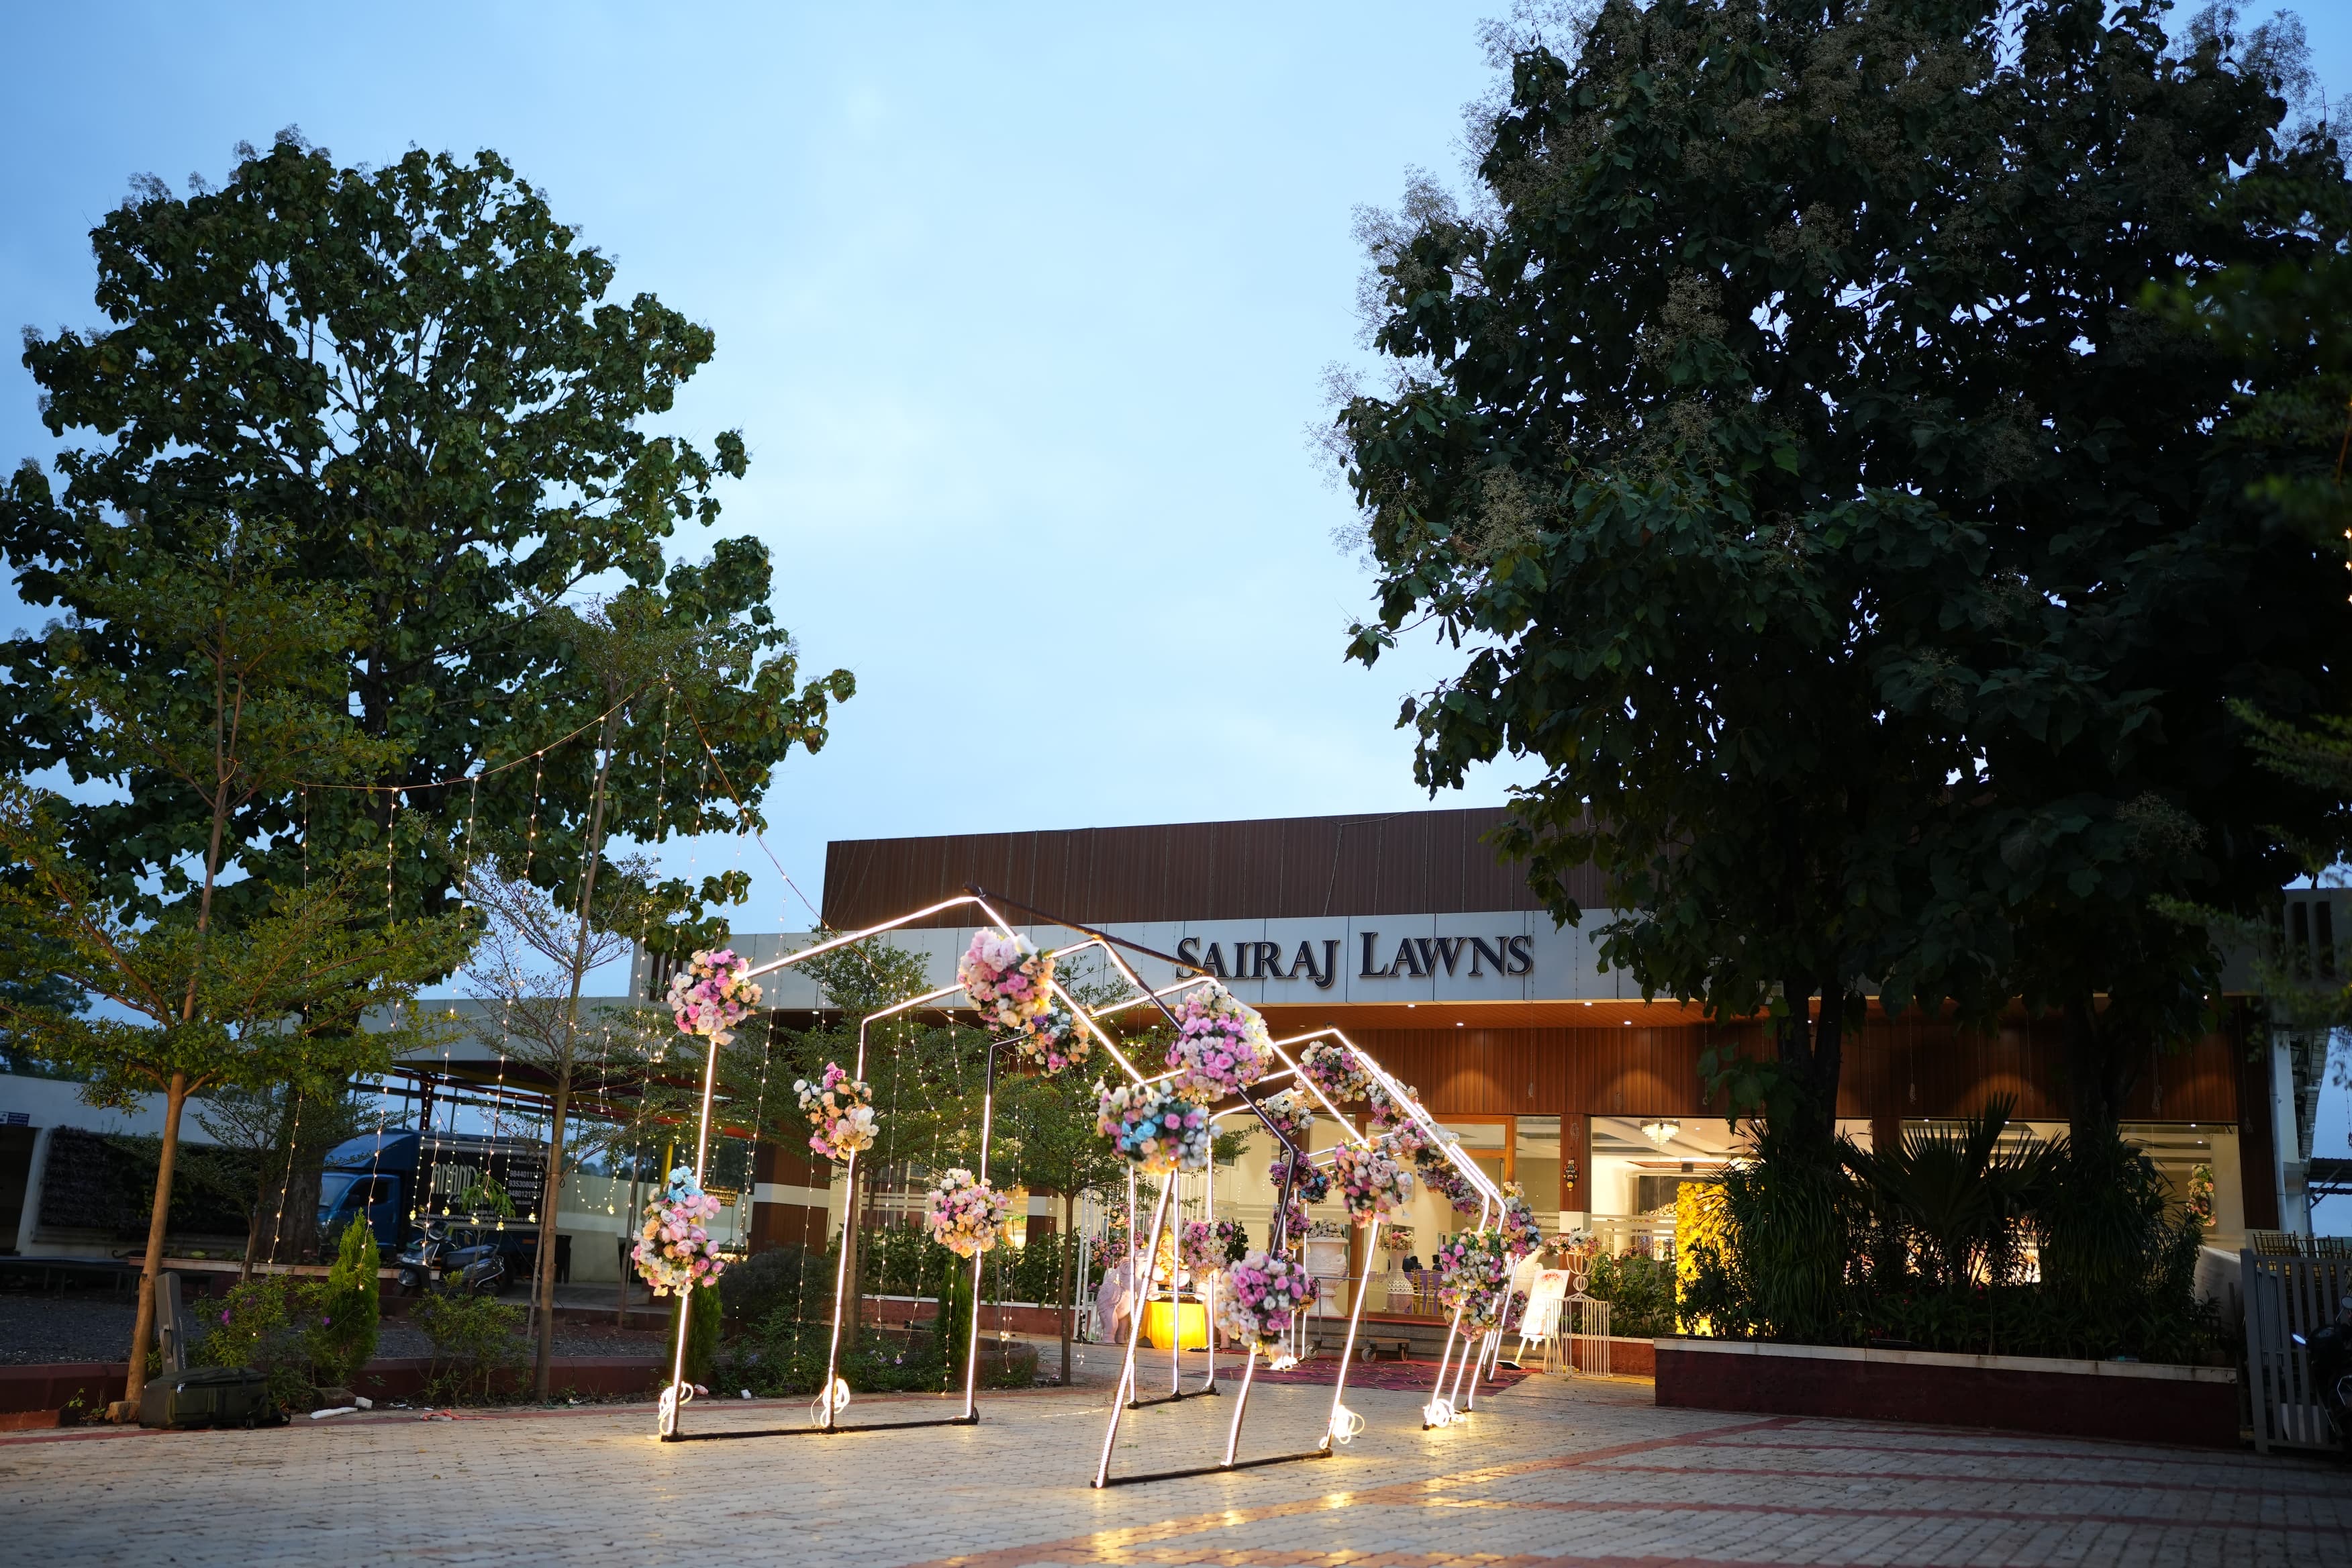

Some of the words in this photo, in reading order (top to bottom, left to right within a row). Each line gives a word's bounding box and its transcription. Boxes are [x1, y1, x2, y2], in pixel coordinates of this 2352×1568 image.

[1176, 936, 1340, 988] SAIRAJ
[1359, 932, 1532, 977] LAWNS
[432, 1163, 478, 1195] ANAND
